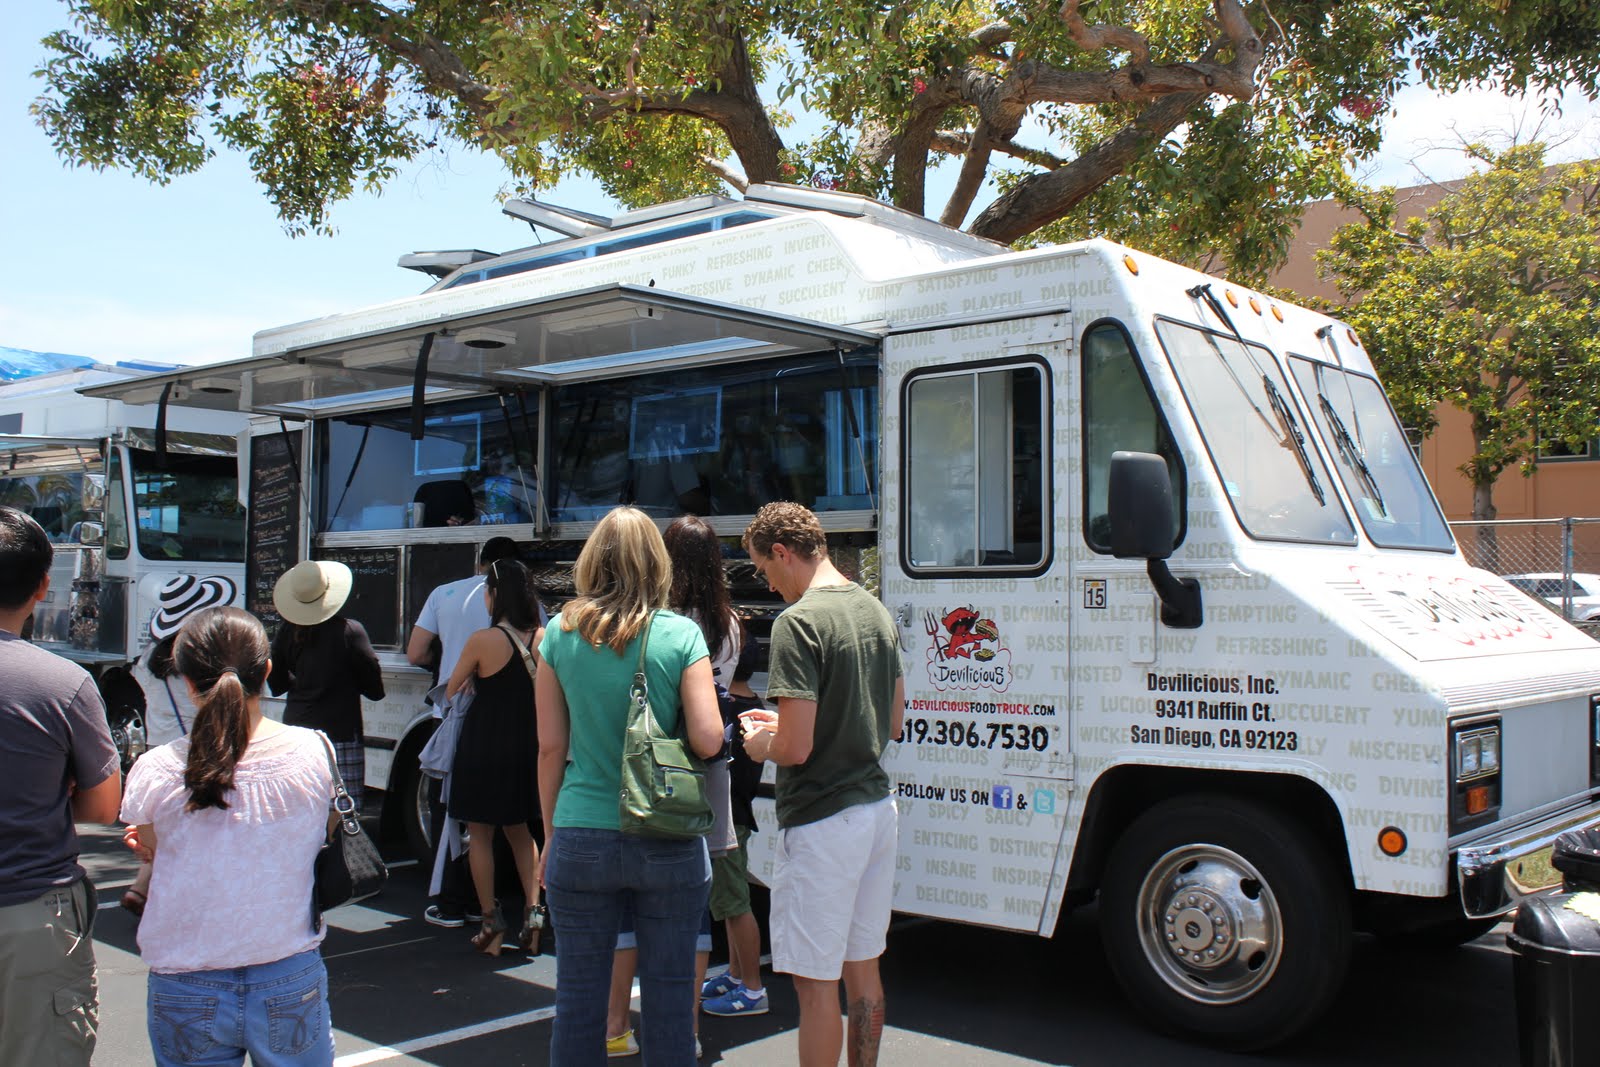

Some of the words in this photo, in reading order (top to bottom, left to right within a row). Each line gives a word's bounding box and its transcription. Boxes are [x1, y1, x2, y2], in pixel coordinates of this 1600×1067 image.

[707, 245, 773, 271] REFRESHING
[744, 264, 796, 287] DYNAMIC
[779, 281, 847, 305] SUCCULENT
[858, 283, 904, 302] YUMMY
[918, 269, 998, 293] SATISFYING
[1014, 256, 1081, 279] DYNAMIC
[962, 290, 1023, 312] PLAYFUL
[1040, 277, 1113, 300] DIABOLIC
[892, 331, 936, 349] DIVINE
[951, 318, 1037, 342] DELECTABLE
[888, 579, 937, 595] INSANE
[952, 578, 1019, 595] INSPIRED
[1034, 575, 1094, 594] WICKE
[1115, 573, 1151, 592] FIER
[1200, 571, 1272, 592] ASCALLY
[1087, 588, 1104, 606] 15
[1002, 605, 1072, 623] BLOWING
[1207, 605, 1297, 624] TEMPTING
[1026, 633, 1125, 652] PASSIONATE
[1138, 635, 1198, 653] FUNKY
[1216, 635, 1328, 657] REFRESHING
[1051, 664, 1122, 683] TWISTED
[1267, 669, 1352, 690] DYNAMIC
[1146, 672, 1244, 695] Devilicious,
[1247, 674, 1280, 695] Inc.
[1155, 699, 1194, 719] 9341
[1197, 701, 1248, 721] Ruffin
[1251, 702, 1277, 723] Ct.
[1272, 702, 1372, 726] UCCULENT
[1080, 726, 1131, 745] WICKE
[1130, 724, 1161, 744] San
[1164, 726, 1216, 749] Diego,
[1218, 728, 1242, 748] CA
[1244, 729, 1298, 751] 92123
[917, 746, 989, 766] DELICIOUS
[1004, 750, 1043, 769] MIND
[1379, 775, 1446, 798] DIVINE
[898, 782, 946, 802] FOLLOW
[950, 788, 967, 804] US
[970, 790, 990, 806] ON
[1016, 792, 1029, 811] &
[928, 802, 970, 821] SPICY
[985, 808, 1035, 827] SAUCY
[913, 829, 979, 851] ENTICING
[925, 857, 977, 880] INSANE
[992, 866, 1063, 889] INSPIRED
[915, 884, 989, 909] DELICIOUS
